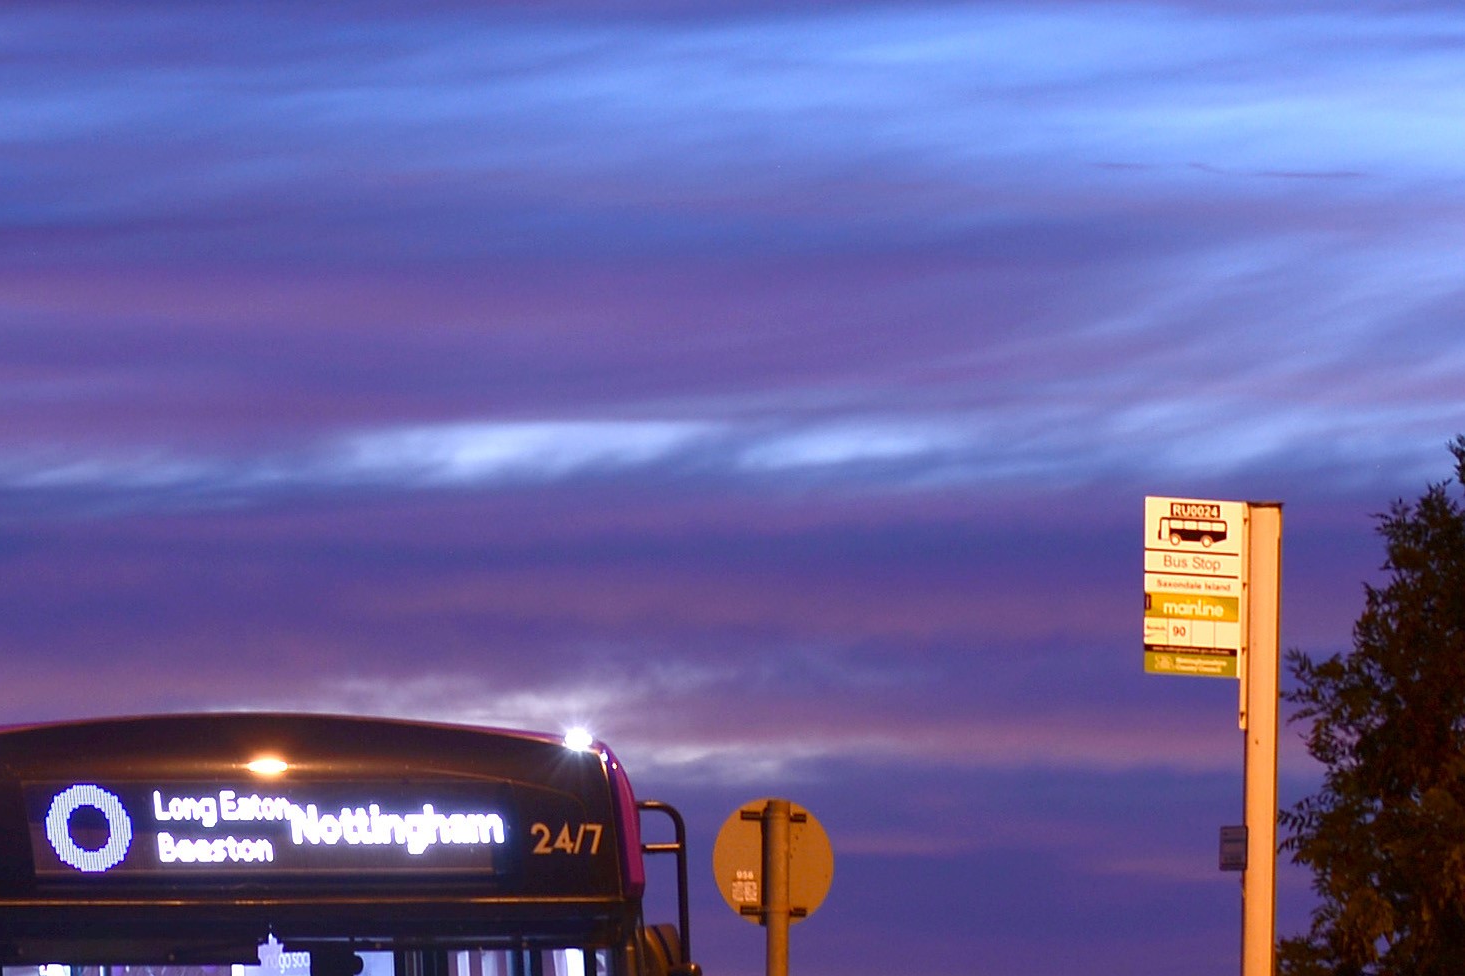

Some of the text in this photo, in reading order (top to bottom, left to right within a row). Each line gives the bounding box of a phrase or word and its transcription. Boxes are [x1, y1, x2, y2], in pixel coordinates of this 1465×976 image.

[1172, 504, 1218, 517] RU0024
[1164, 555, 1221, 572] Bus Stop
[1157, 579, 1231, 591] Saxondale Island
[1163, 599, 1224, 617] mainline
[1172, 626, 1186, 637] 90
[153, 790, 291, 827] Long Eaton
[290, 804, 504, 855] Nottingham
[530, 820, 603, 854] 24/7
[157, 832, 274, 862] Beeston
